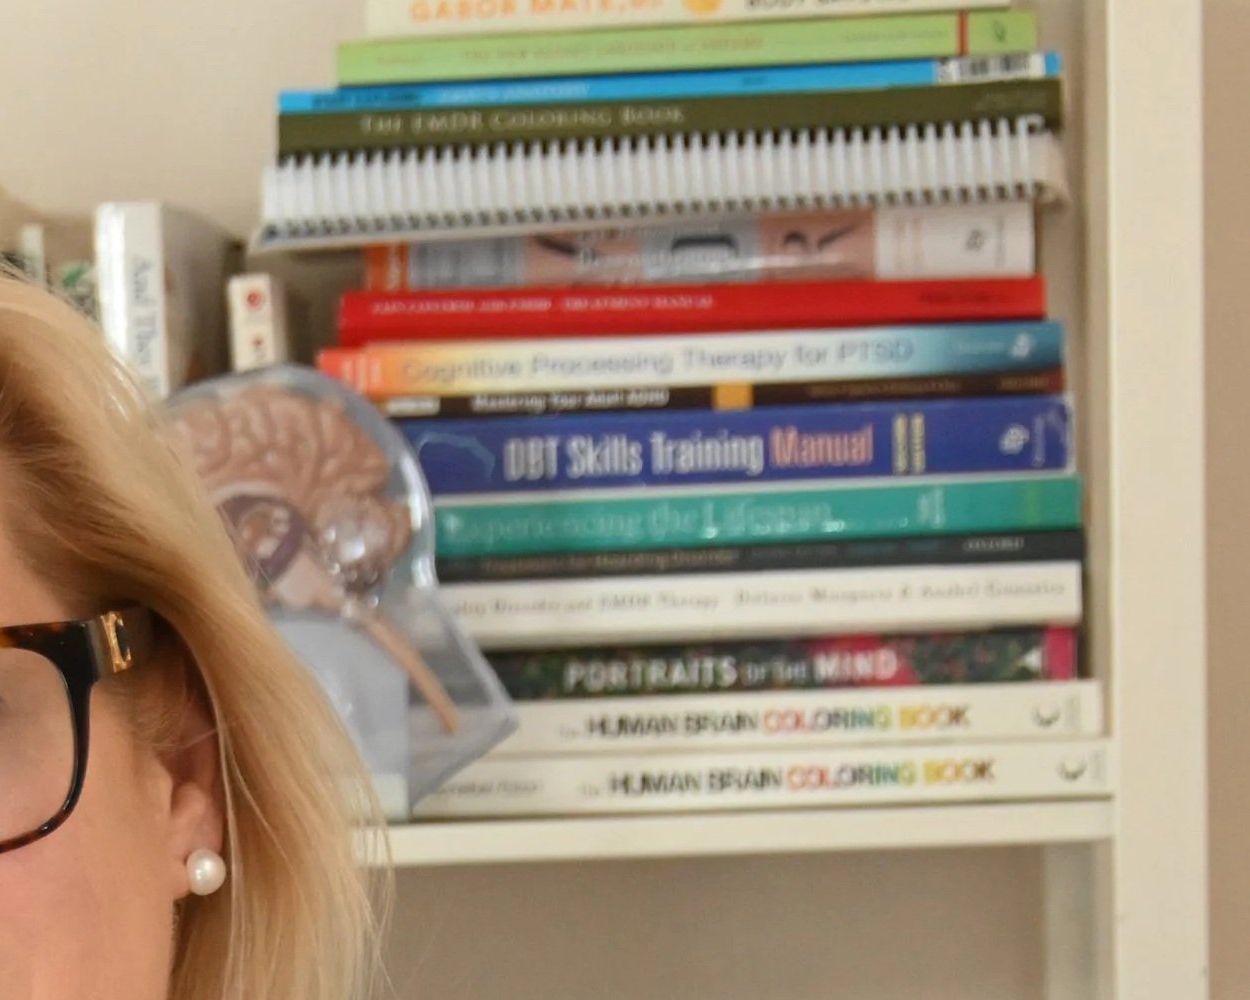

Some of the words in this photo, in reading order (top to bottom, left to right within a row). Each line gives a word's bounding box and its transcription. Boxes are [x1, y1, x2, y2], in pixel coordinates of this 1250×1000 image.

[411, 110, 484, 135] EMDR
[489, 107, 612, 131] COLORING
[620, 105, 686, 126] BOOK
[401, 354, 524, 384] Cognitive
[532, 350, 673, 378] Processing
[682, 347, 787, 373] Therapy
[794, 343, 829, 366] for
[836, 340, 913, 363] PTSD
[504, 436, 558, 482] DBT
[565, 434, 644, 478] Skills
[650, 429, 764, 476] Training
[768, 423, 874, 468] Manual
[563, 656, 739, 693] PORTRAITS
[813, 650, 900, 683] MIND
[586, 712, 678, 740] HUMAN
[682, 709, 760, 736] BRAIN
[762, 705, 893, 733] COLORING
[898, 703, 972, 727] BOOK
[607, 771, 701, 797] HUMAN
[706, 768, 784, 794] BRAIN
[786, 762, 918, 792] COLORING
[922, 759, 997, 785] BOOK
